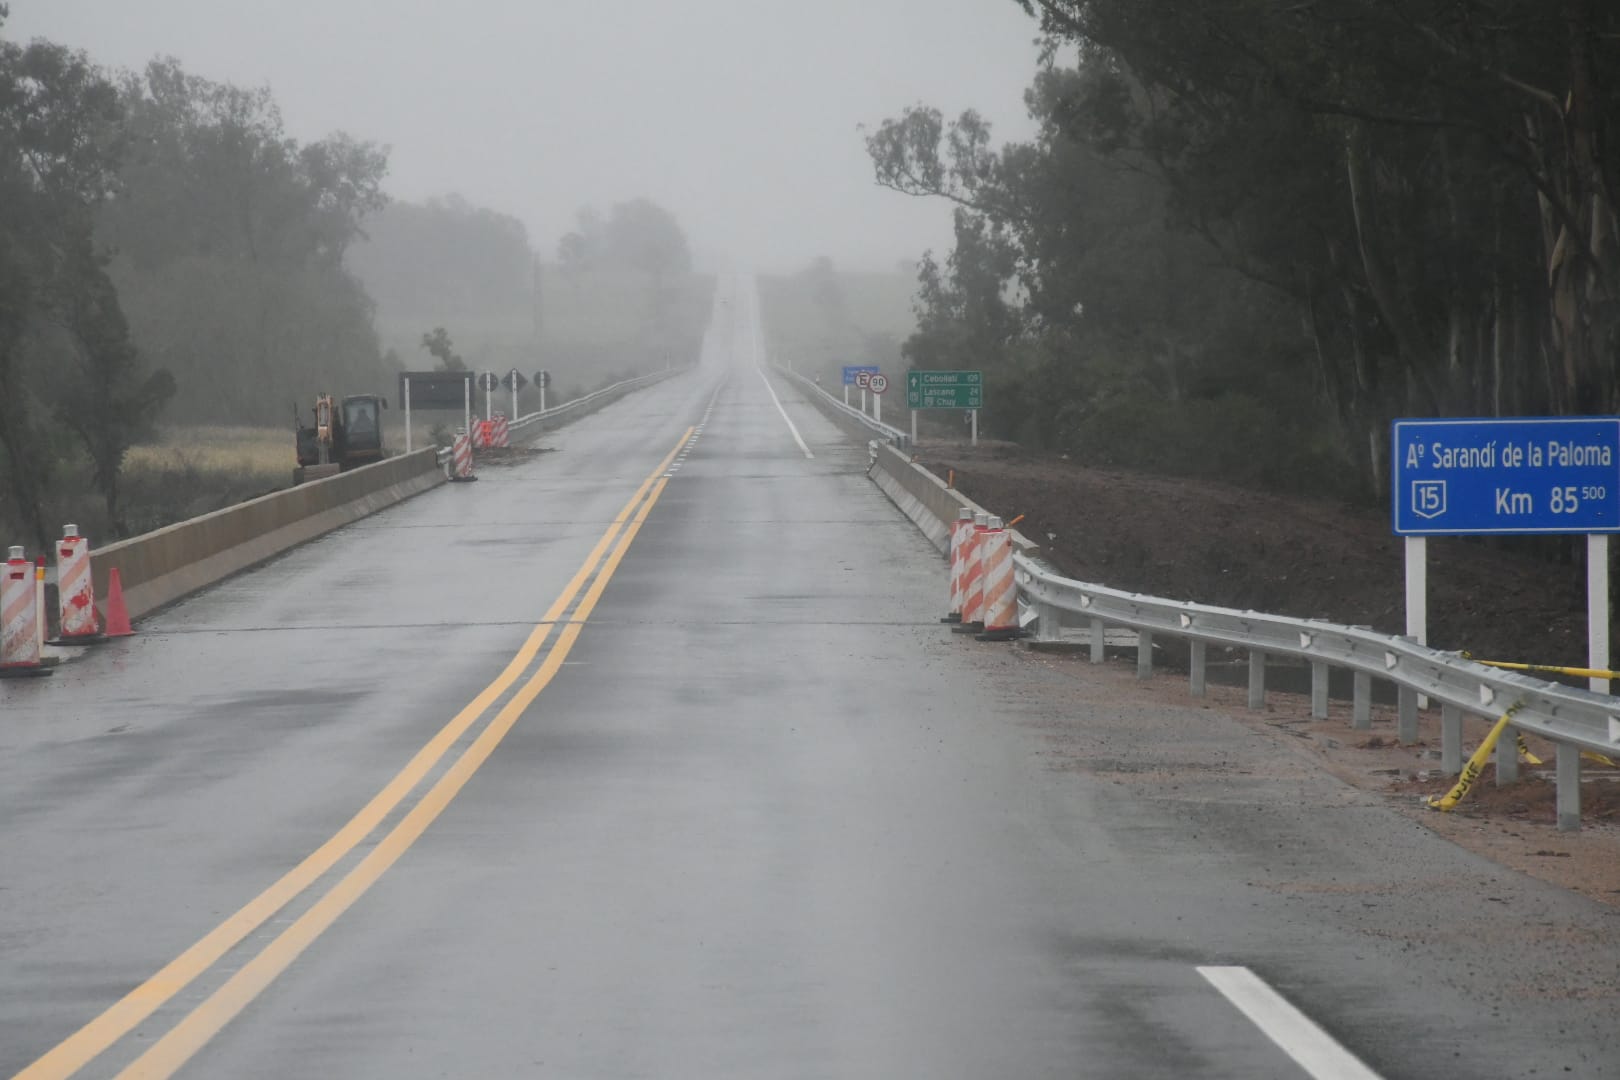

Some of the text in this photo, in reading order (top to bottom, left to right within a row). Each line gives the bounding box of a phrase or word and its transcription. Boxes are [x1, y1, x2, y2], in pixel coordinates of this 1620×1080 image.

[872, 378, 884, 386] 90
[924, 387, 956, 396] Lascano
[936, 398, 956, 407] Chuy
[1432, 440, 1497, 469] Sarandí
[1502, 442, 1523, 468] de
[1528, 442, 1542, 467] la
[1548, 441, 1611, 467] Paloma
[1419, 486, 1606, 514] 15 Km 85 500
